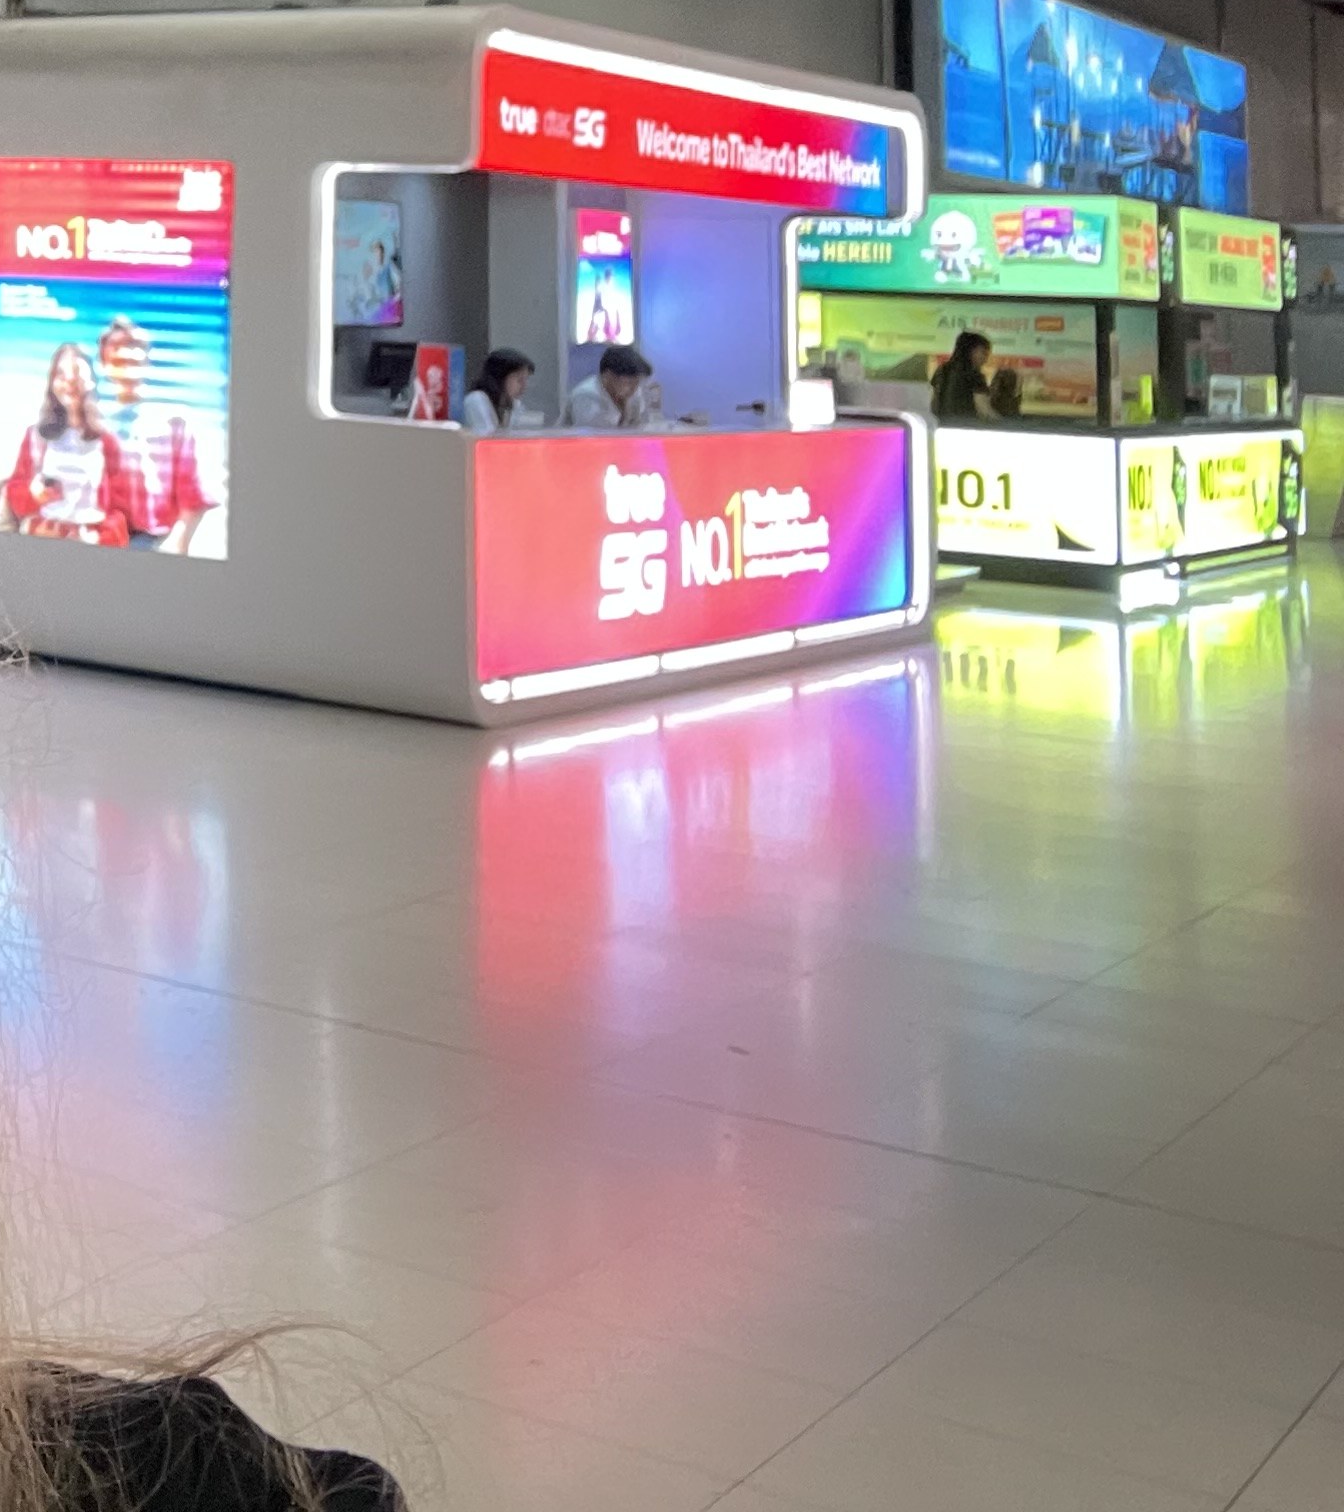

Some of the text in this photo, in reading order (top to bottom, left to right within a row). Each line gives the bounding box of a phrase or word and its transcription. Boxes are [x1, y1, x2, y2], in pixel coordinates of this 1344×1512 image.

[500, 96, 537, 135] true
[573, 106, 607, 148] 5G
[636, 118, 881, 188] Welcome to Thailand's Best Network
[822, 240, 892, 263] HERE!!!
[598, 529, 667, 620] 5G
[681, 492, 742, 587] NO.1
